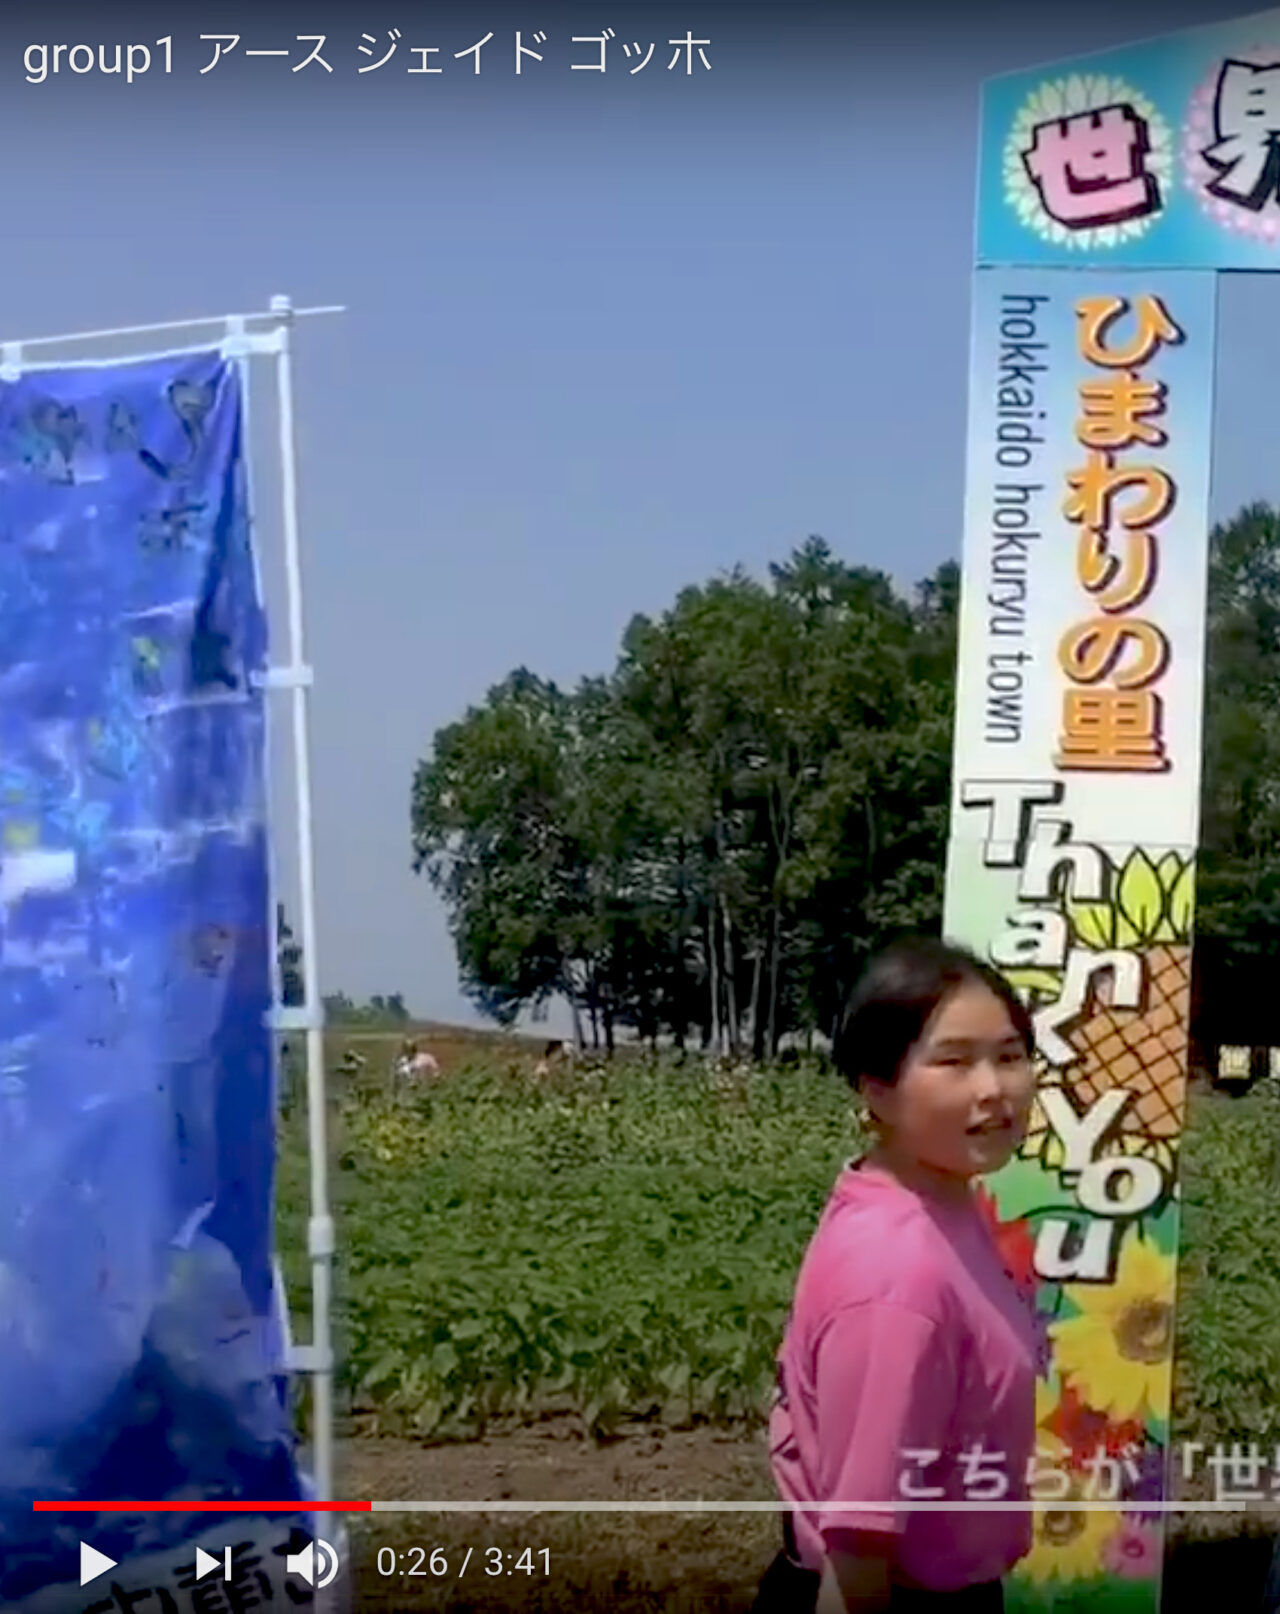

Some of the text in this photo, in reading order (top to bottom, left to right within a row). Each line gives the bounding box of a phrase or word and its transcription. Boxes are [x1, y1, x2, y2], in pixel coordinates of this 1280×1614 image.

[985, 294, 1050, 744] hokkaido hokuryu town
[1054, 293, 1187, 773] ひまわりの里
[1036, 1085, 1168, 1285] You
